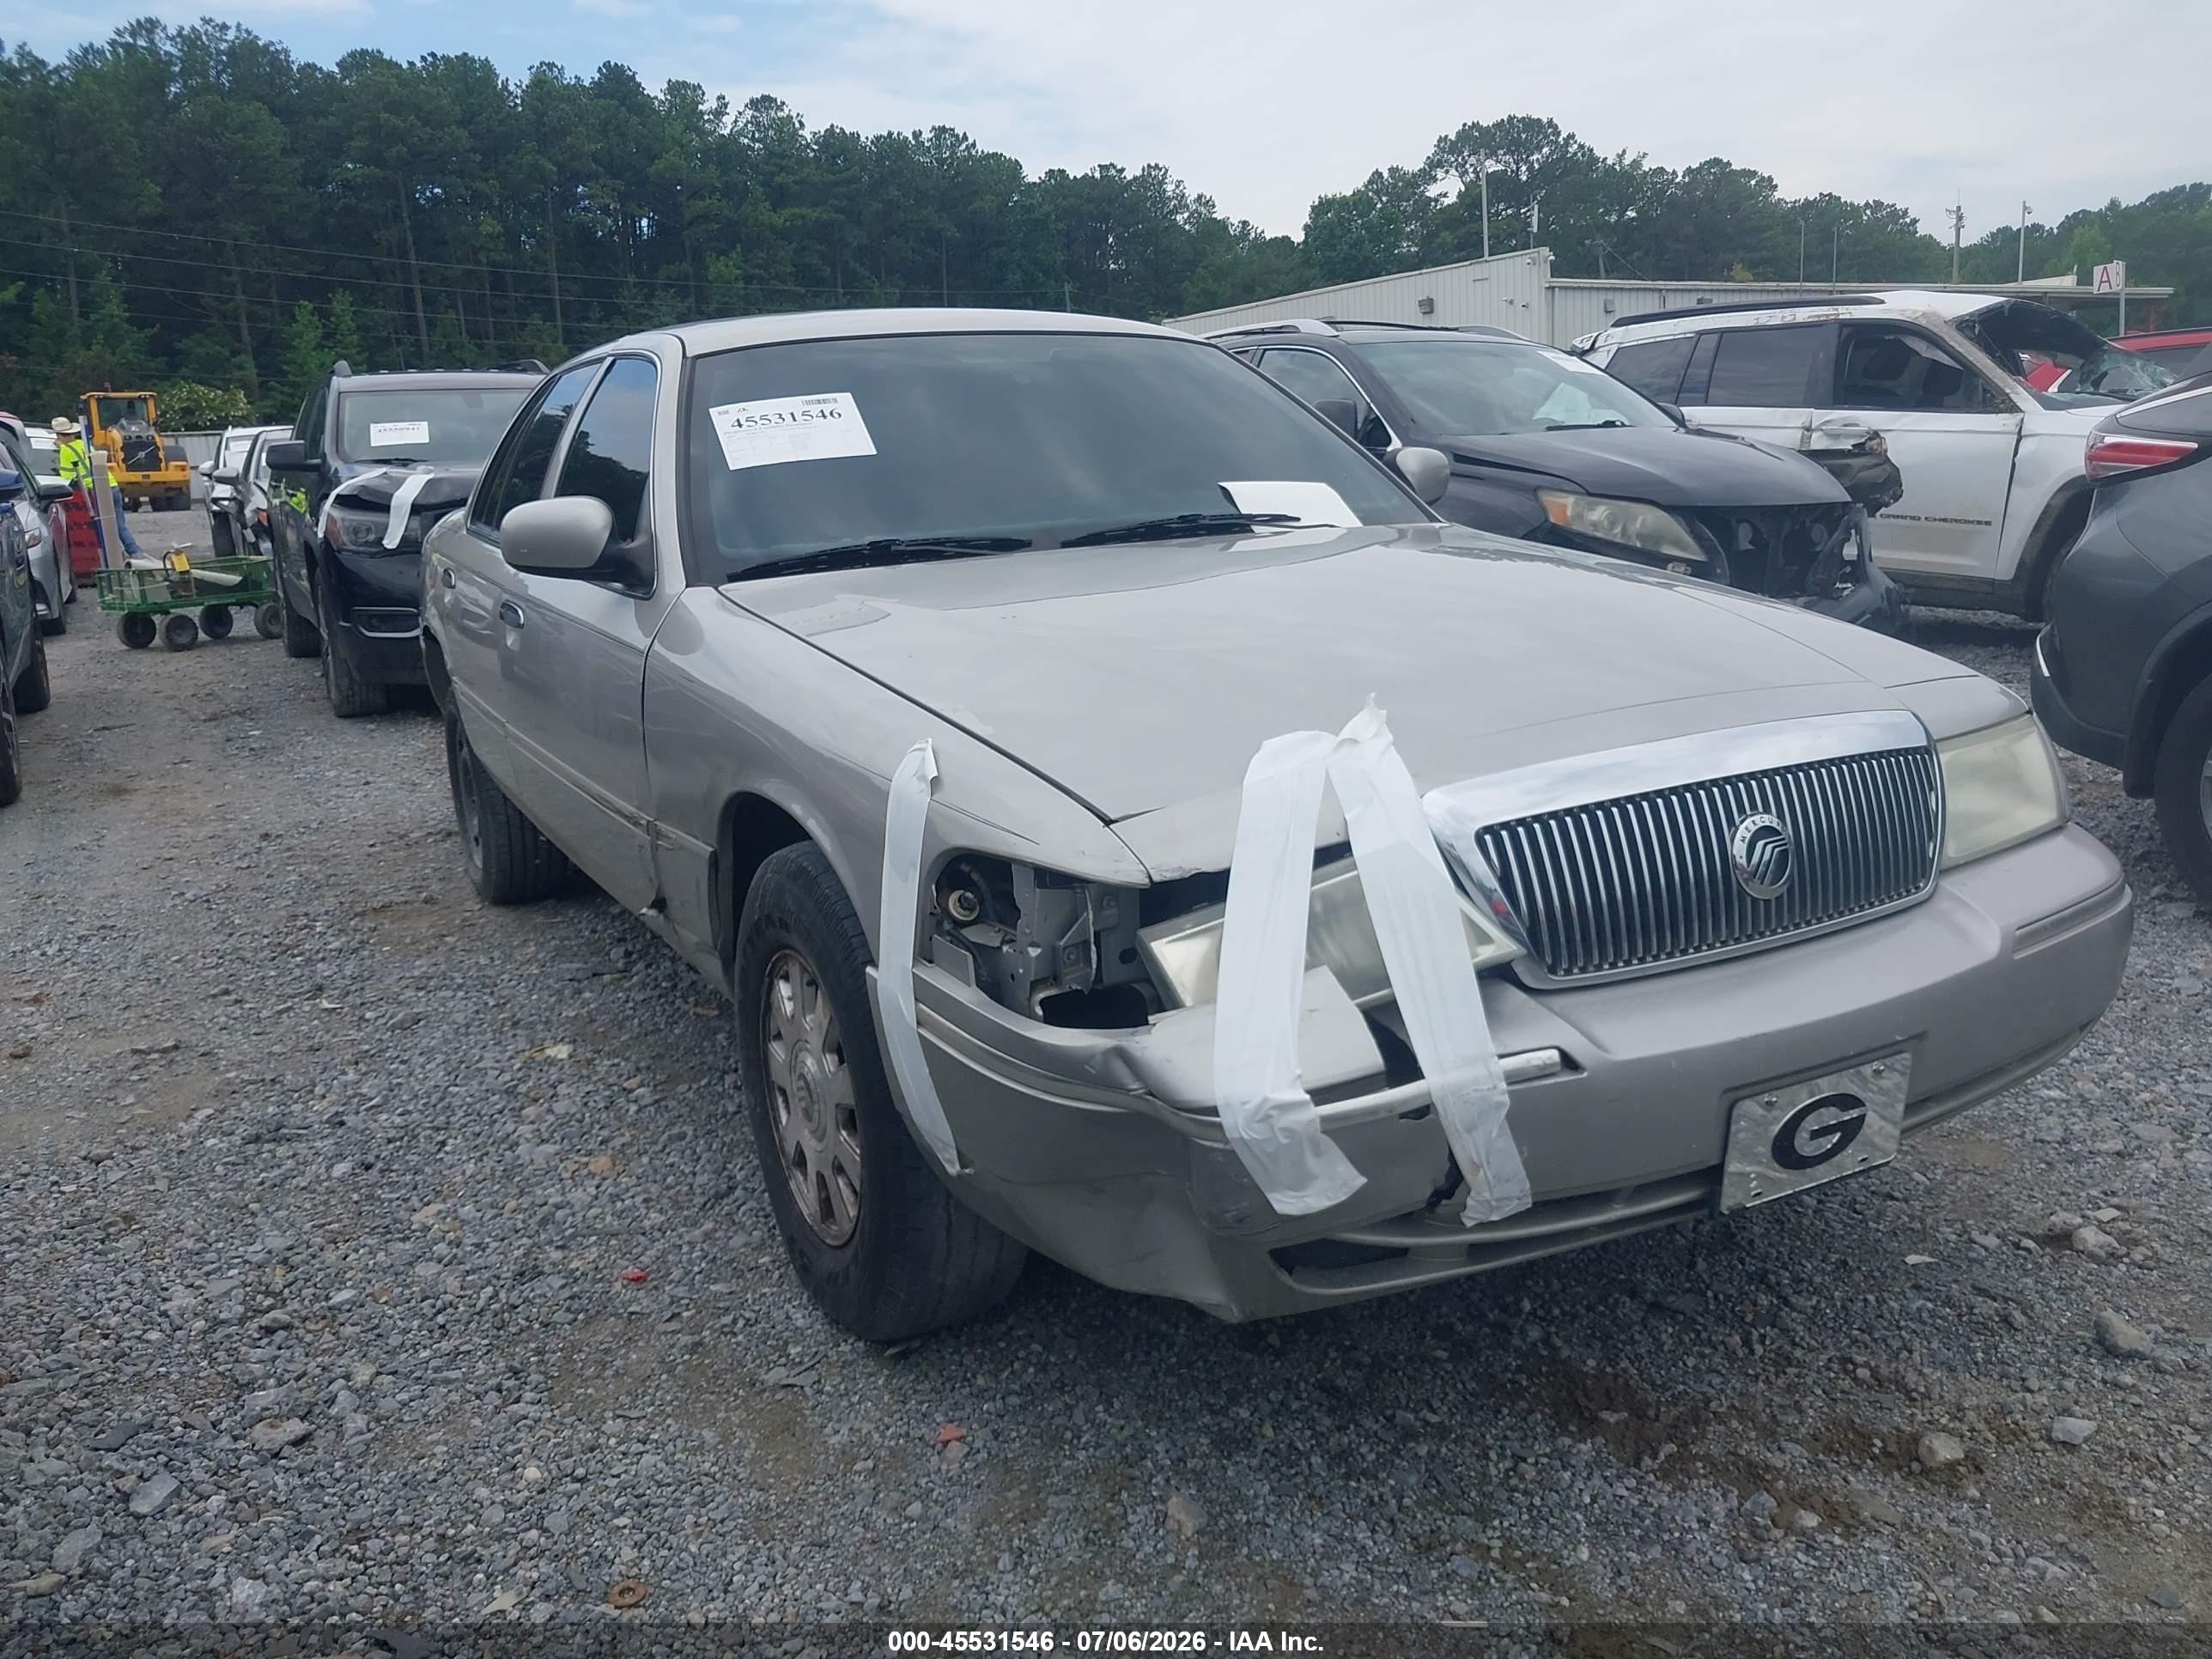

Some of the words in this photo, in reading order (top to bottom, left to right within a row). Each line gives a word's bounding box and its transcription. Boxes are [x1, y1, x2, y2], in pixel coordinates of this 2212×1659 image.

[2097, 265, 2112, 292] A
[2115, 261, 2121, 287] B
[731, 408, 842, 428] 45531546
[1923, 516, 1992, 526] CHEROKEE
[1771, 1092, 1868, 1170] G
